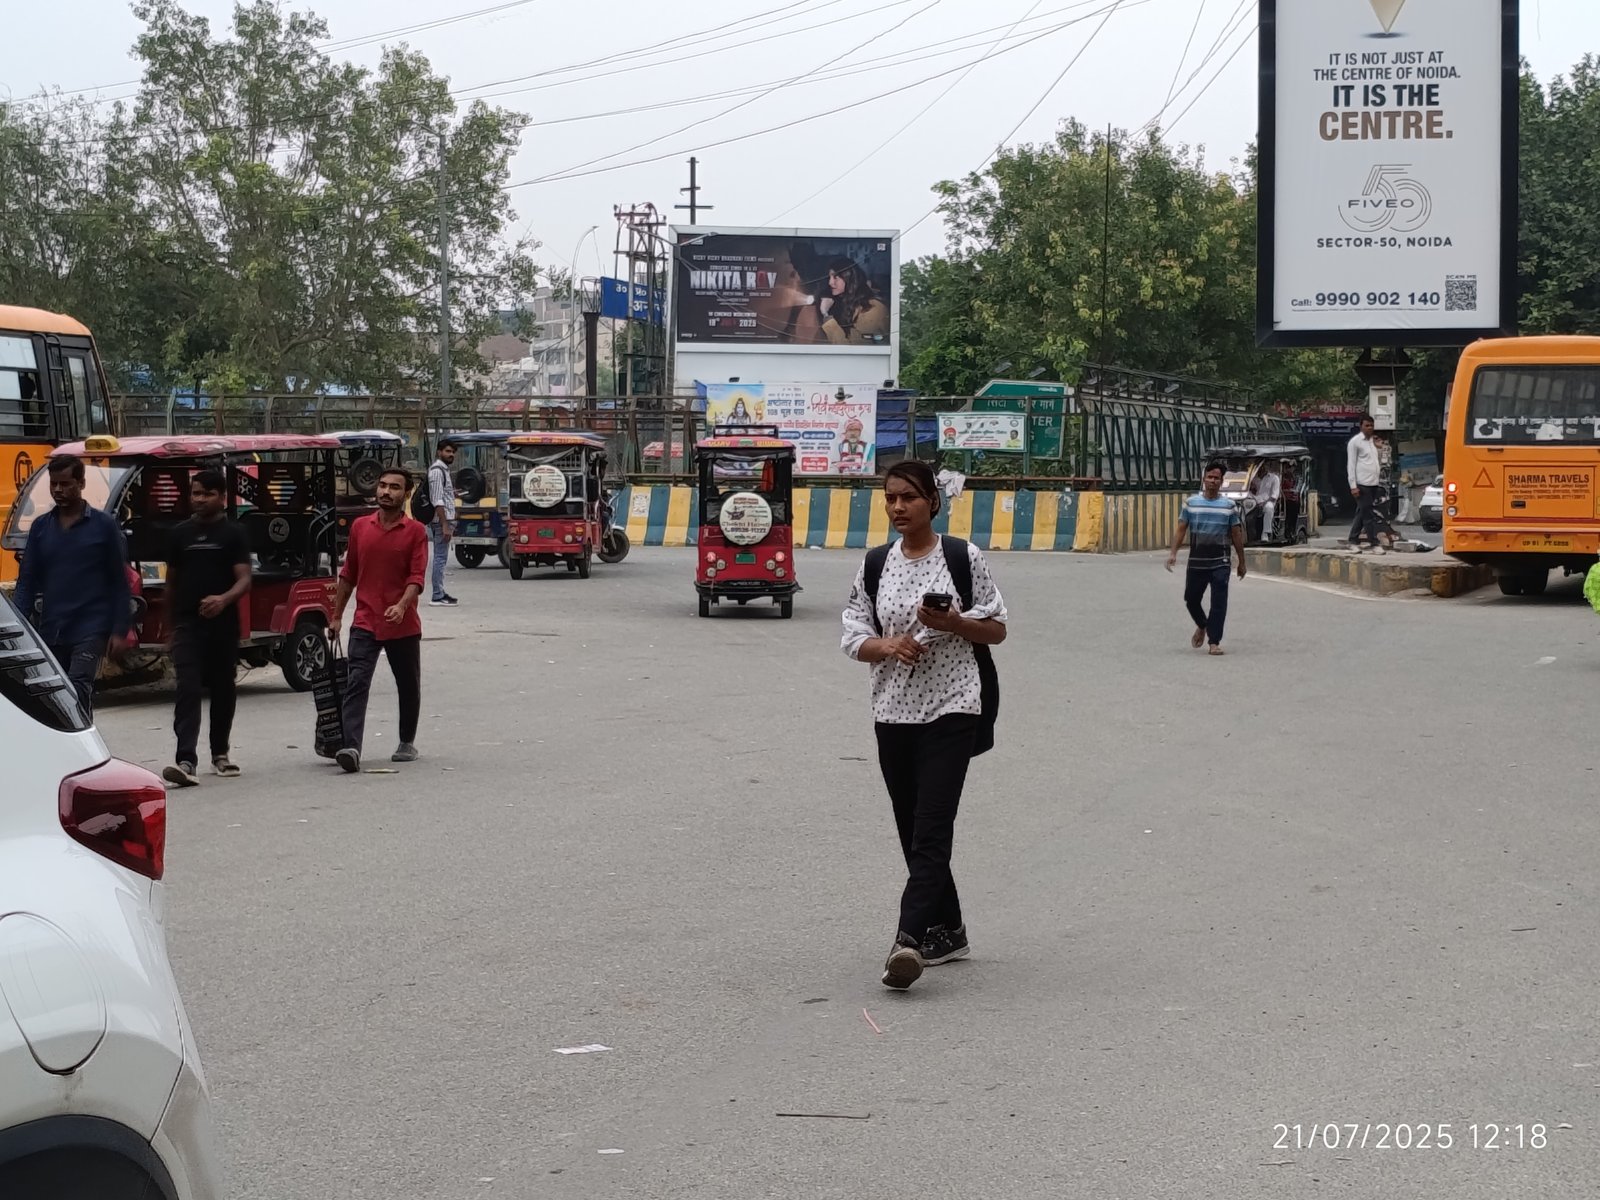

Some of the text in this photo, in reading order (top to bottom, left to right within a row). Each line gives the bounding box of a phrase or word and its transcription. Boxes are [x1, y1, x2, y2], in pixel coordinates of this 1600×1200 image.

[1329, 51, 1444, 66] IT IS NOT JUST AT
[1313, 66, 1461, 81] THE CENTRE OF NOIDA.
[1332, 84, 1440, 107] IT IS THE
[1319, 110, 1453, 141] CENTRE.
[1316, 237, 1453, 249] SECTOR-50, NOIDA
[690, 271, 741, 290] NIKITA
[1291, 292, 1441, 307] Call: 9990 902 140
[1508, 474, 1590, 484] SHARMA TRAVELS
